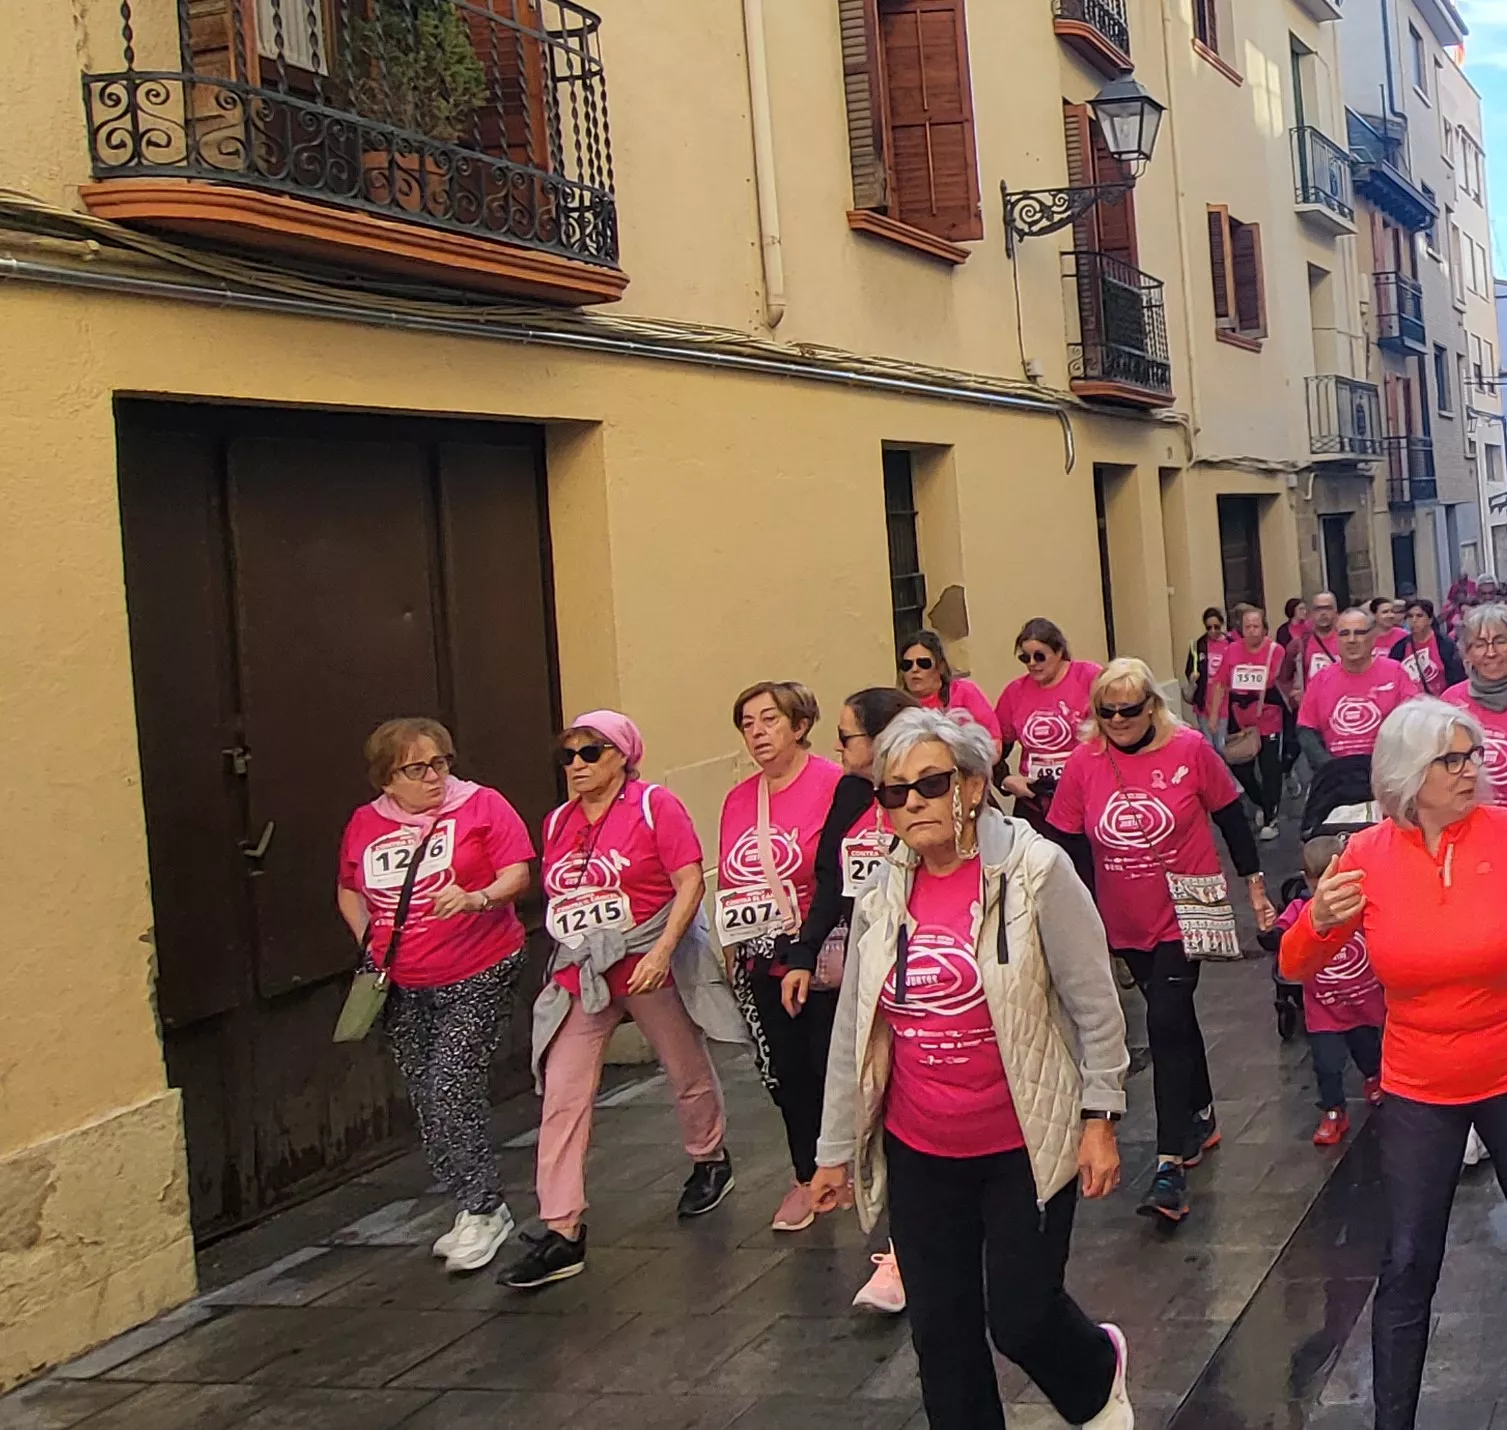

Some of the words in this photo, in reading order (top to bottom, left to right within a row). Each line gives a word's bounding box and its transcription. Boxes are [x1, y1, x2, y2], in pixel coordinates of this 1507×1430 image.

[375, 838, 443, 872] 126
[556, 900, 622, 934] 1215
[725, 902, 781, 929] 207
